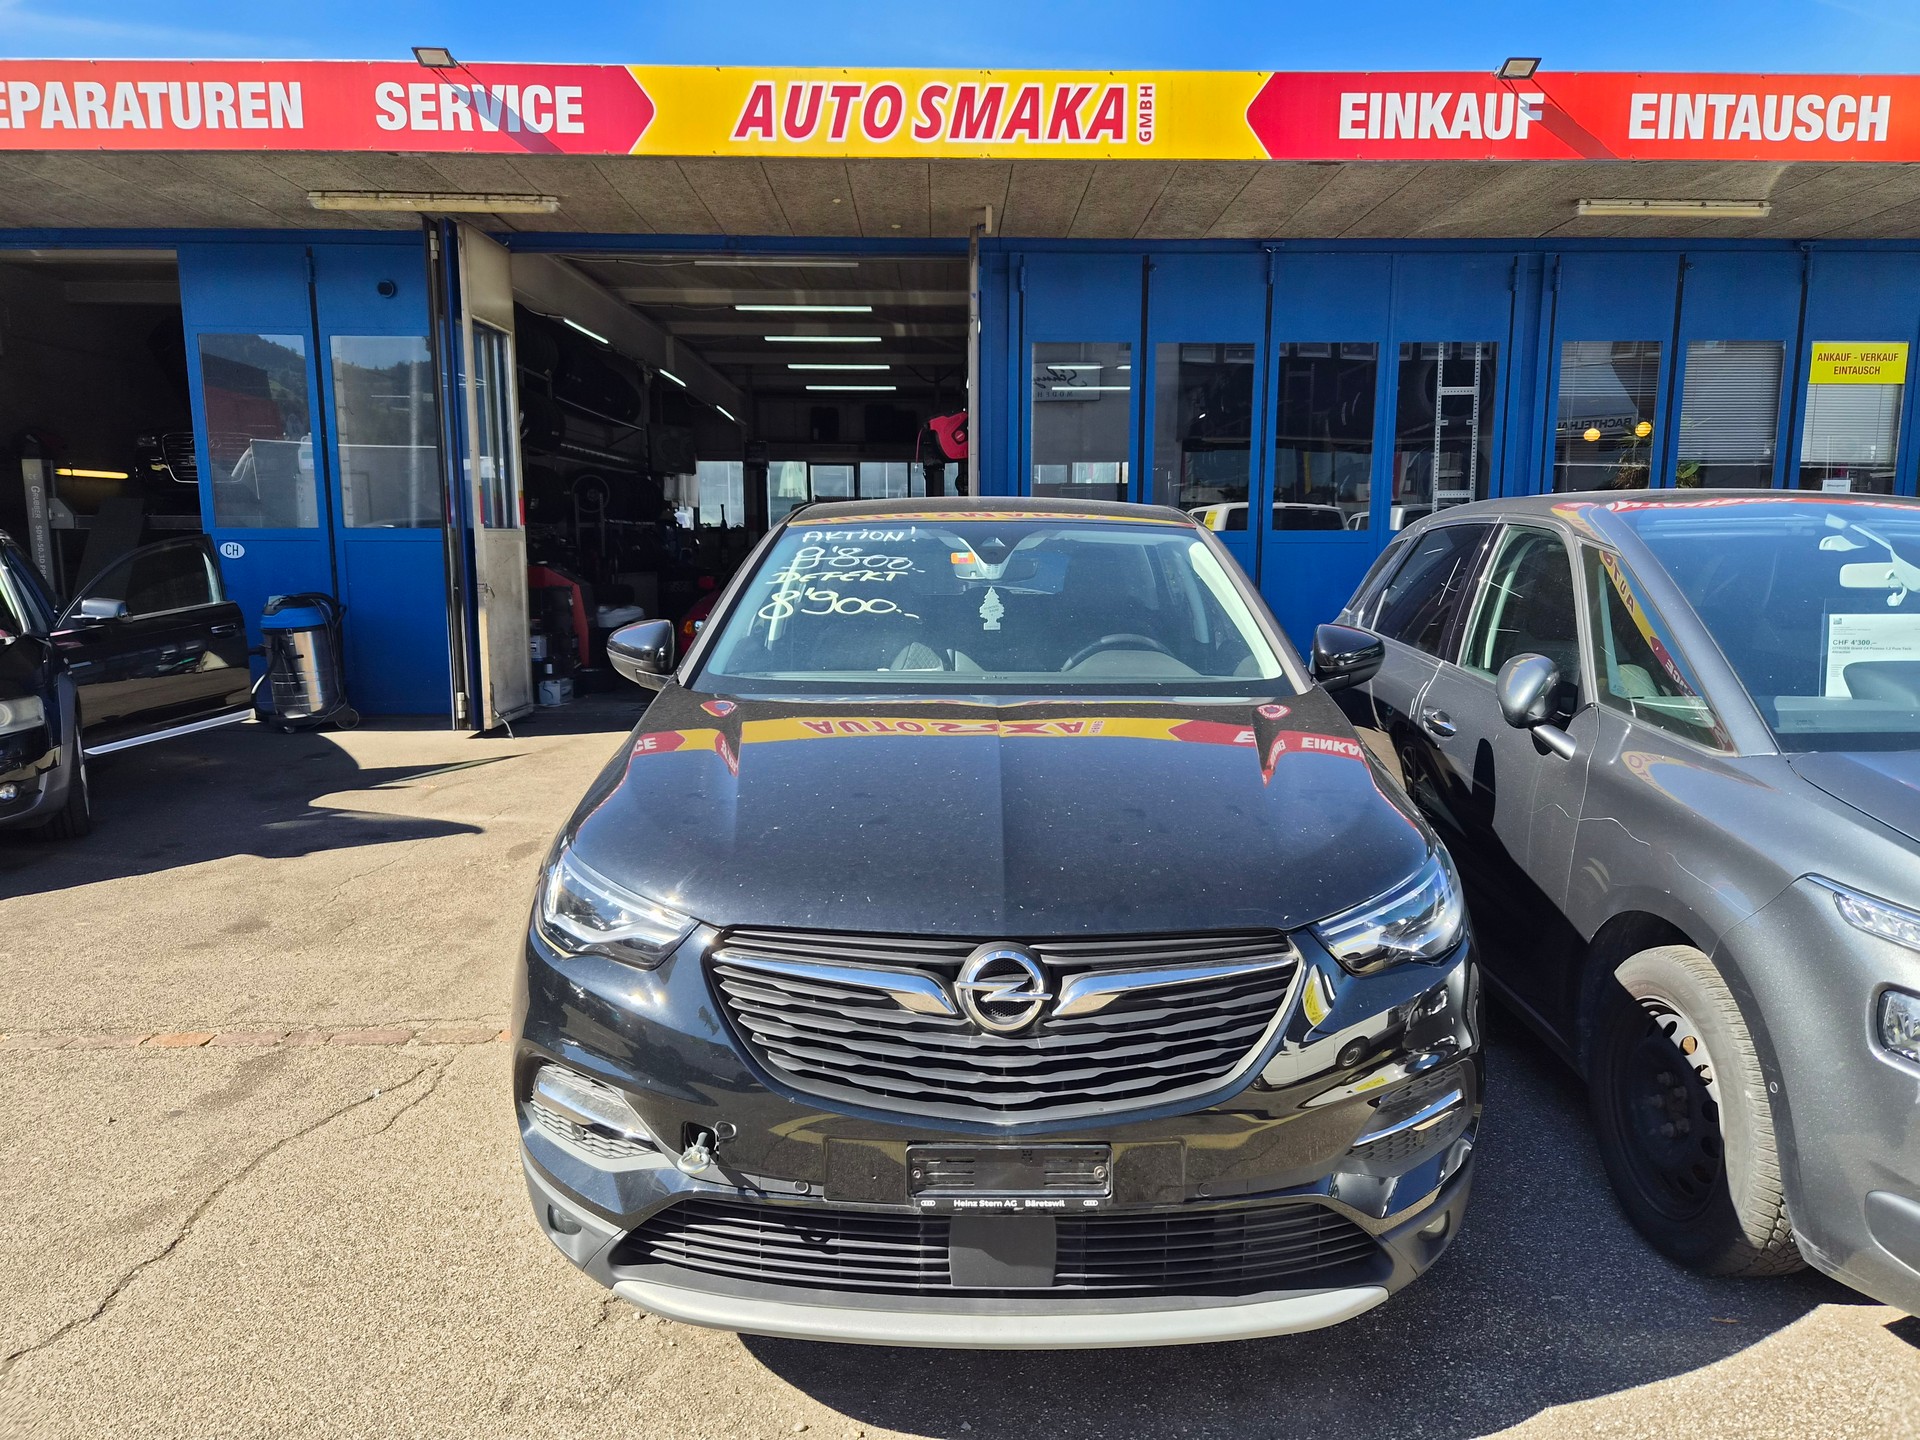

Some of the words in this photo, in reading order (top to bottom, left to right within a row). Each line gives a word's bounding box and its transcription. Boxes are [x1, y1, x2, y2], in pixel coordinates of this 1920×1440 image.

[374, 82, 585, 134] SERVICE
[733, 83, 905, 141] AUTO
[912, 83, 1126, 142] SMAKA
[1137, 84, 1153, 143] GMBH
[1338, 92, 1545, 140] EINKAUF
[1628, 93, 1891, 142] EINTAUSCH
[1817, 352, 1852, 361] ANKAUF
[1860, 352, 1899, 361] VERKAUF
[1833, 366, 1881, 375] EINTAUSCH
[225, 544, 239, 556] CH
[953, 1199, 978, 1207] Heinz
[1003, 1199, 1018, 1207] AG
